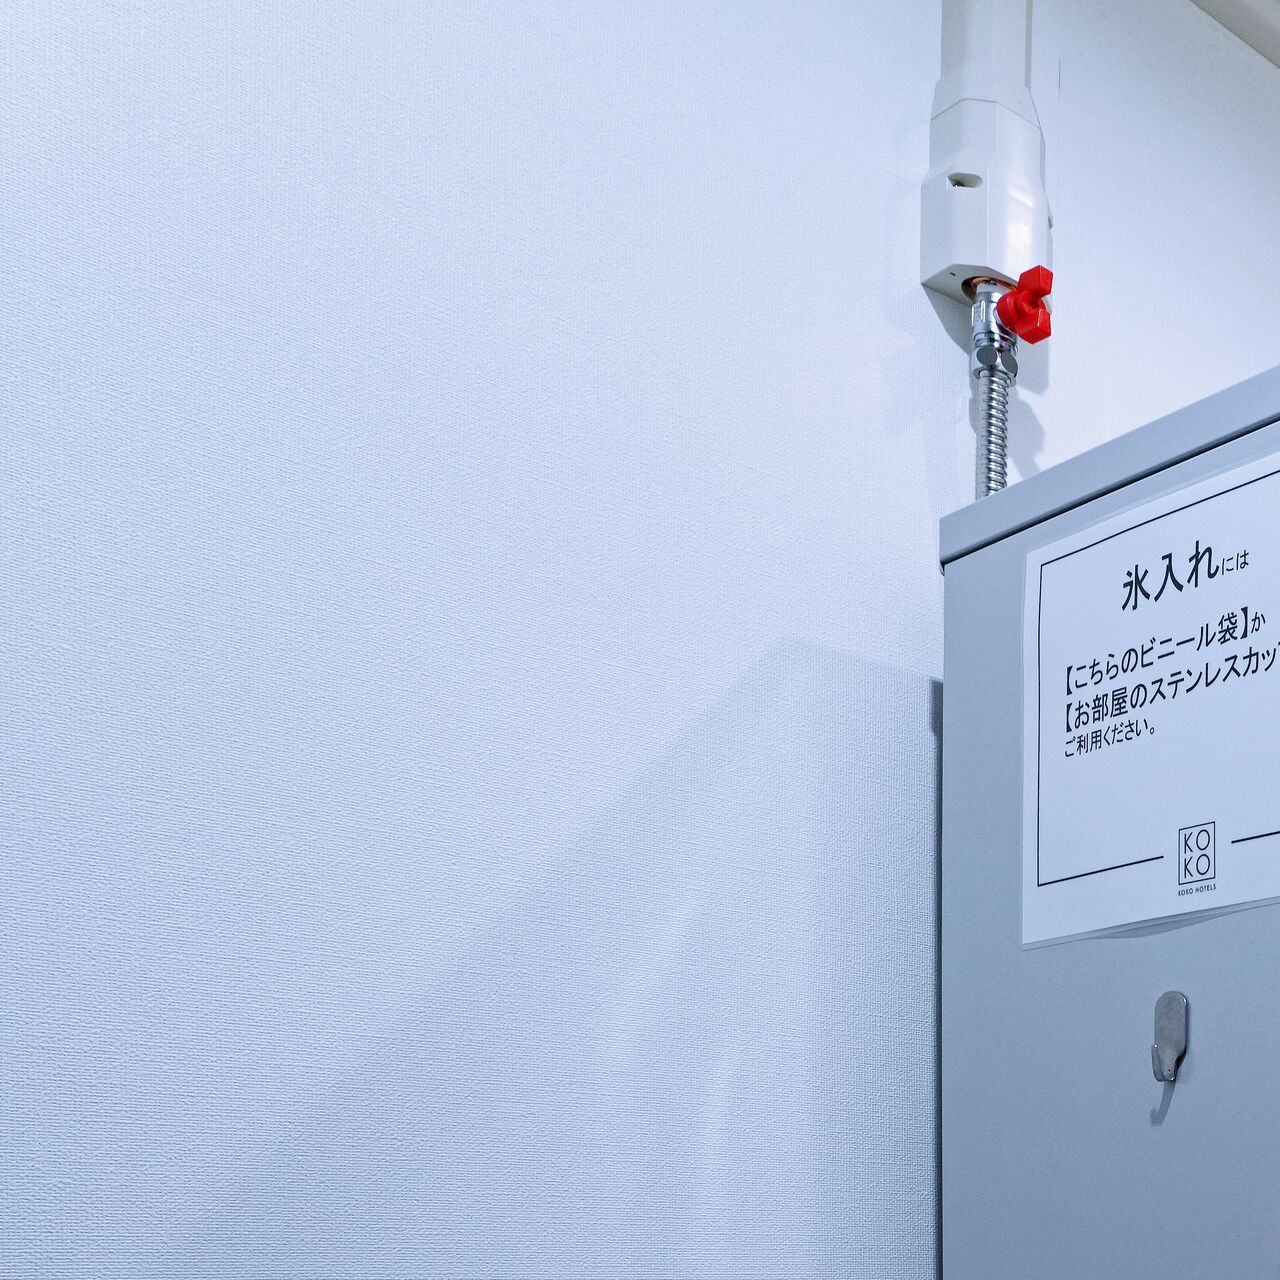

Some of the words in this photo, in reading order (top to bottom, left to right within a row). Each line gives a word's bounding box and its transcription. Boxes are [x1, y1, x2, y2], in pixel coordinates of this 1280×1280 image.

[1121, 539, 1250, 611] 氷入れには
[1065, 606, 1266, 695] 【こちらのビニール袋】か
[1064, 721, 1156, 758] ご利用ください。
[1178, 887, 1194, 897] KOKO
[1195, 883, 1217, 894] HOTELS
